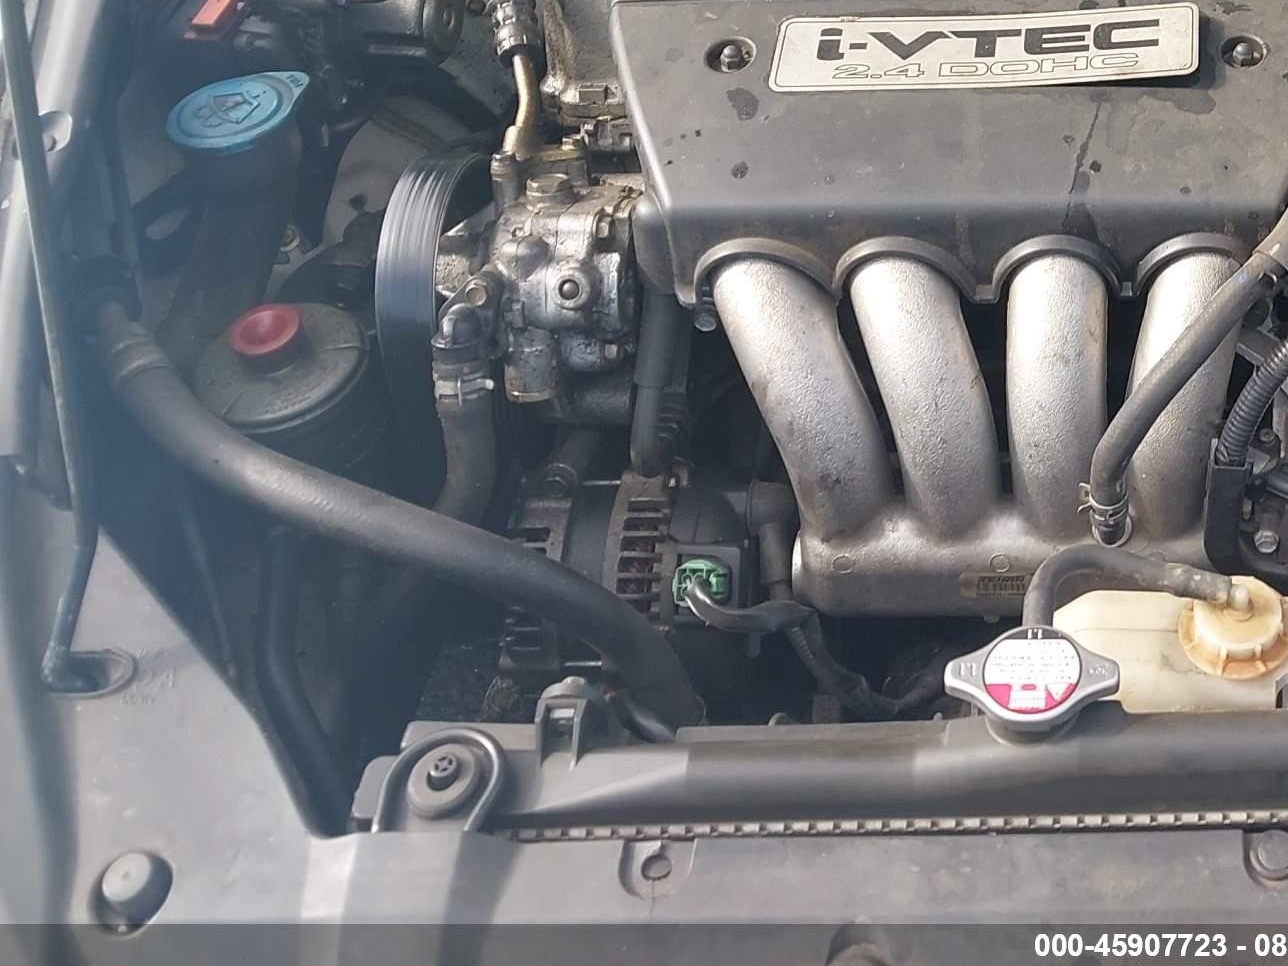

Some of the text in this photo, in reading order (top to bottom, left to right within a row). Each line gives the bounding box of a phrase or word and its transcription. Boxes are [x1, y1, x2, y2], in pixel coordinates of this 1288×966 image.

[816, 18, 1160, 62] i-VTEC
[832, 52, 1140, 80] 2.4 DOHC
